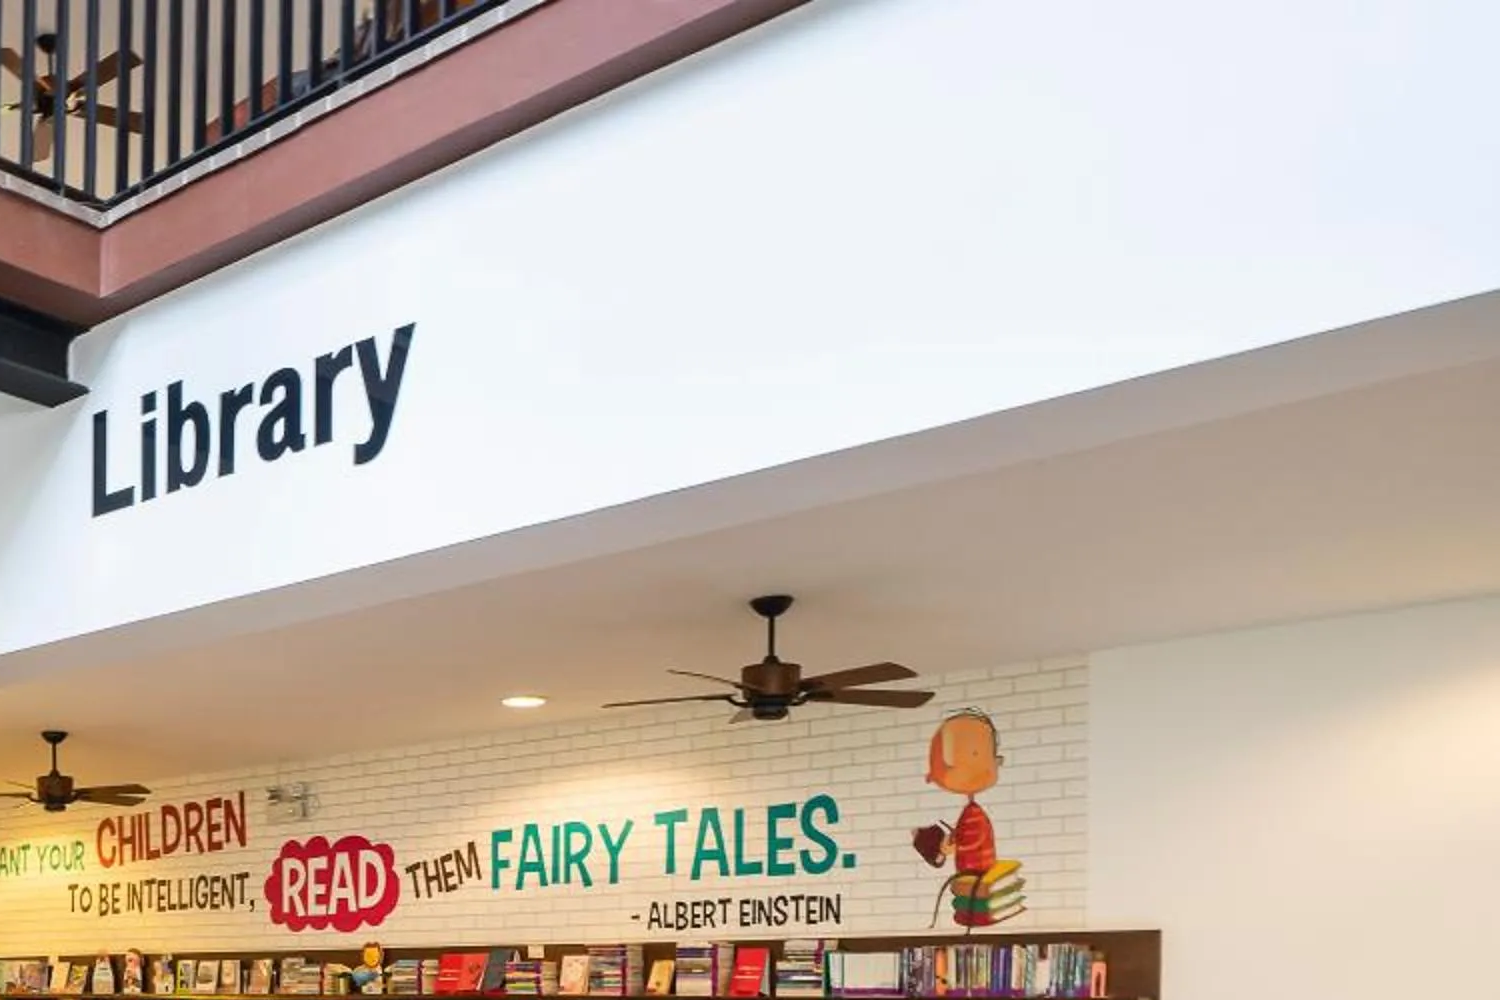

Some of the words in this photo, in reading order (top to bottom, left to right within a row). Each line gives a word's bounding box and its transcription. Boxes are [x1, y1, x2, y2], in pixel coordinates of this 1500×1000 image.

[92, 322, 416, 518] Library
[36, 839, 86, 874] YOUR
[96, 790, 247, 869] CHILDREN
[68, 883, 93, 913] TO
[99, 882, 121, 917] BE
[126, 871, 256, 914] INTELLIGENT,
[281, 849, 387, 918] READ
[404, 841, 483, 899] THEM
[491, 817, 634, 891] FAIRY
[654, 793, 857, 881] TALES.
[647, 897, 732, 931] ALBERT
[739, 894, 842, 927] EINSTEIN
